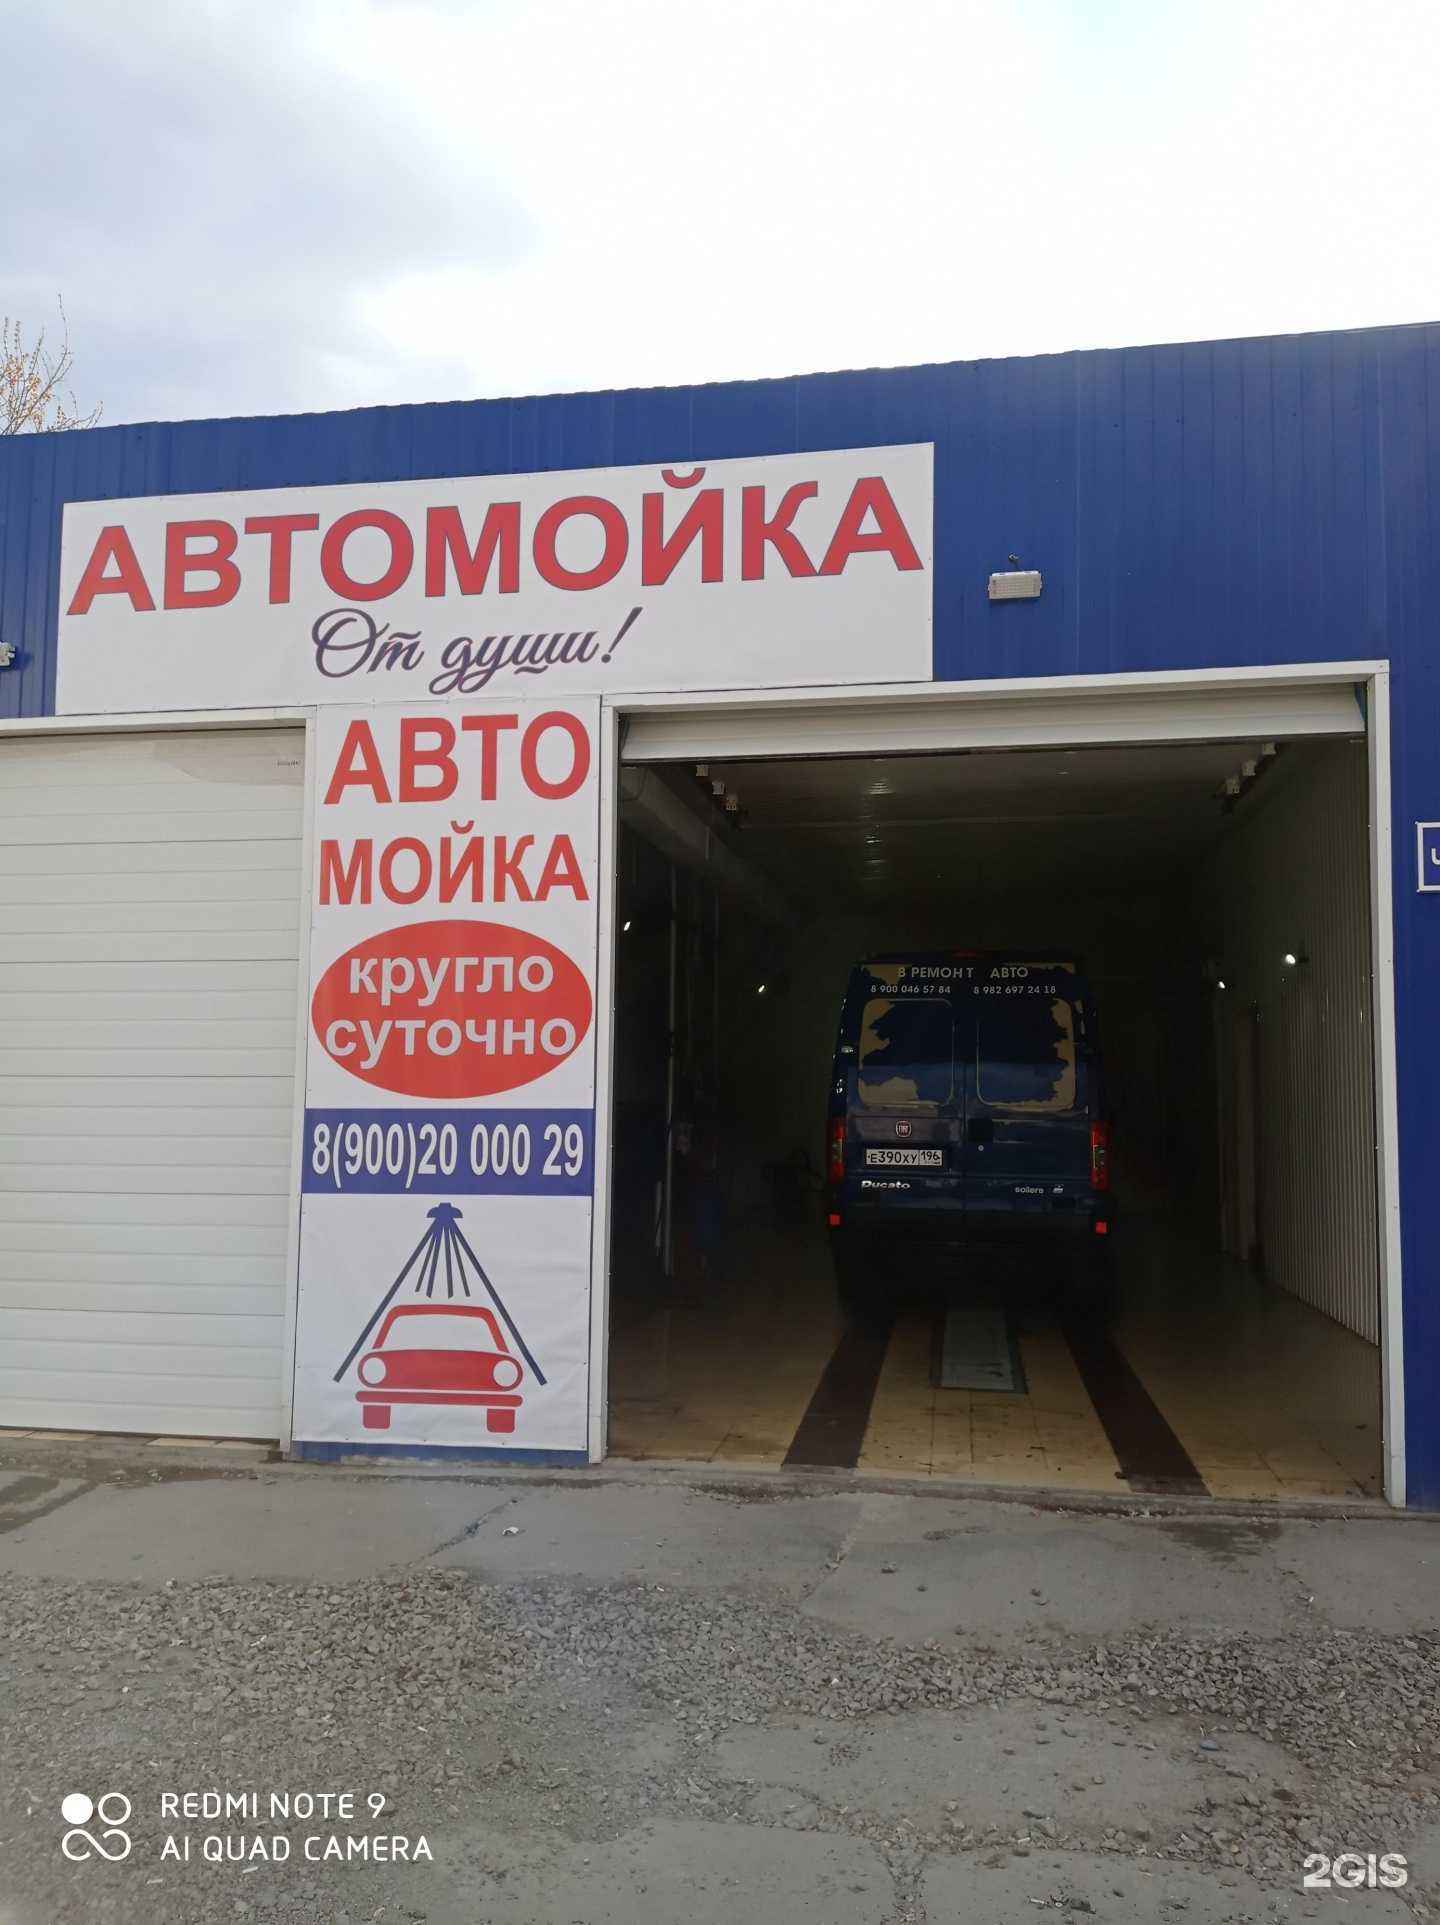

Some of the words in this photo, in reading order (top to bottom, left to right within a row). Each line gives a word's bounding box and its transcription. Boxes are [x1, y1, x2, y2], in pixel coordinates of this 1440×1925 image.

[66, 468, 924, 617] АВТОМОЙКА
[310, 607, 424, 679] От
[427, 605, 643, 695] души!
[323, 710, 591, 805] АВТО
[319, 820, 590, 905] МОЙКА
[348, 955, 555, 1007] кругло
[938, 985, 951, 993] 84
[990, 967, 1028, 978] АВТО
[325, 1017, 577, 1070] суточно
[311, 1122, 458, 1190] 8(900)20
[469, 1122, 531, 1177] 000
[542, 1123, 584, 1177] 29
[861, 1180, 911, 1189] Ducato
